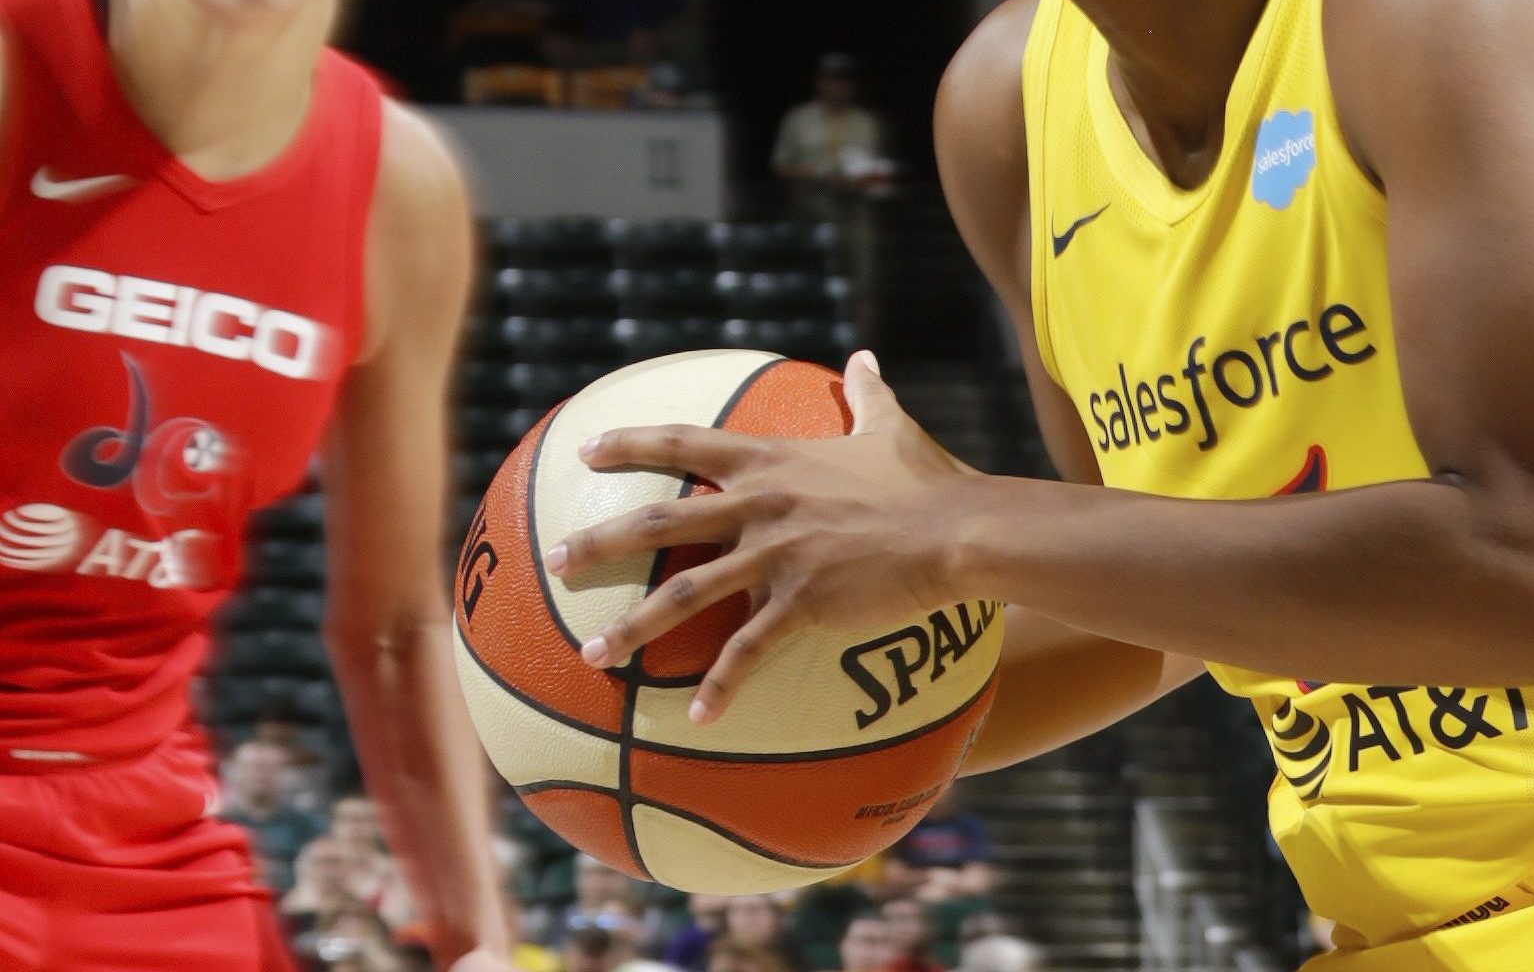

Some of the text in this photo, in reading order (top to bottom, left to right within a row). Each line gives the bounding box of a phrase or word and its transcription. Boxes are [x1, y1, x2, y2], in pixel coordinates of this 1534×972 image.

[34, 264, 332, 382] GEICO
[1089, 303, 1378, 452] salesforce
[840, 599, 1003, 731] SPALD
